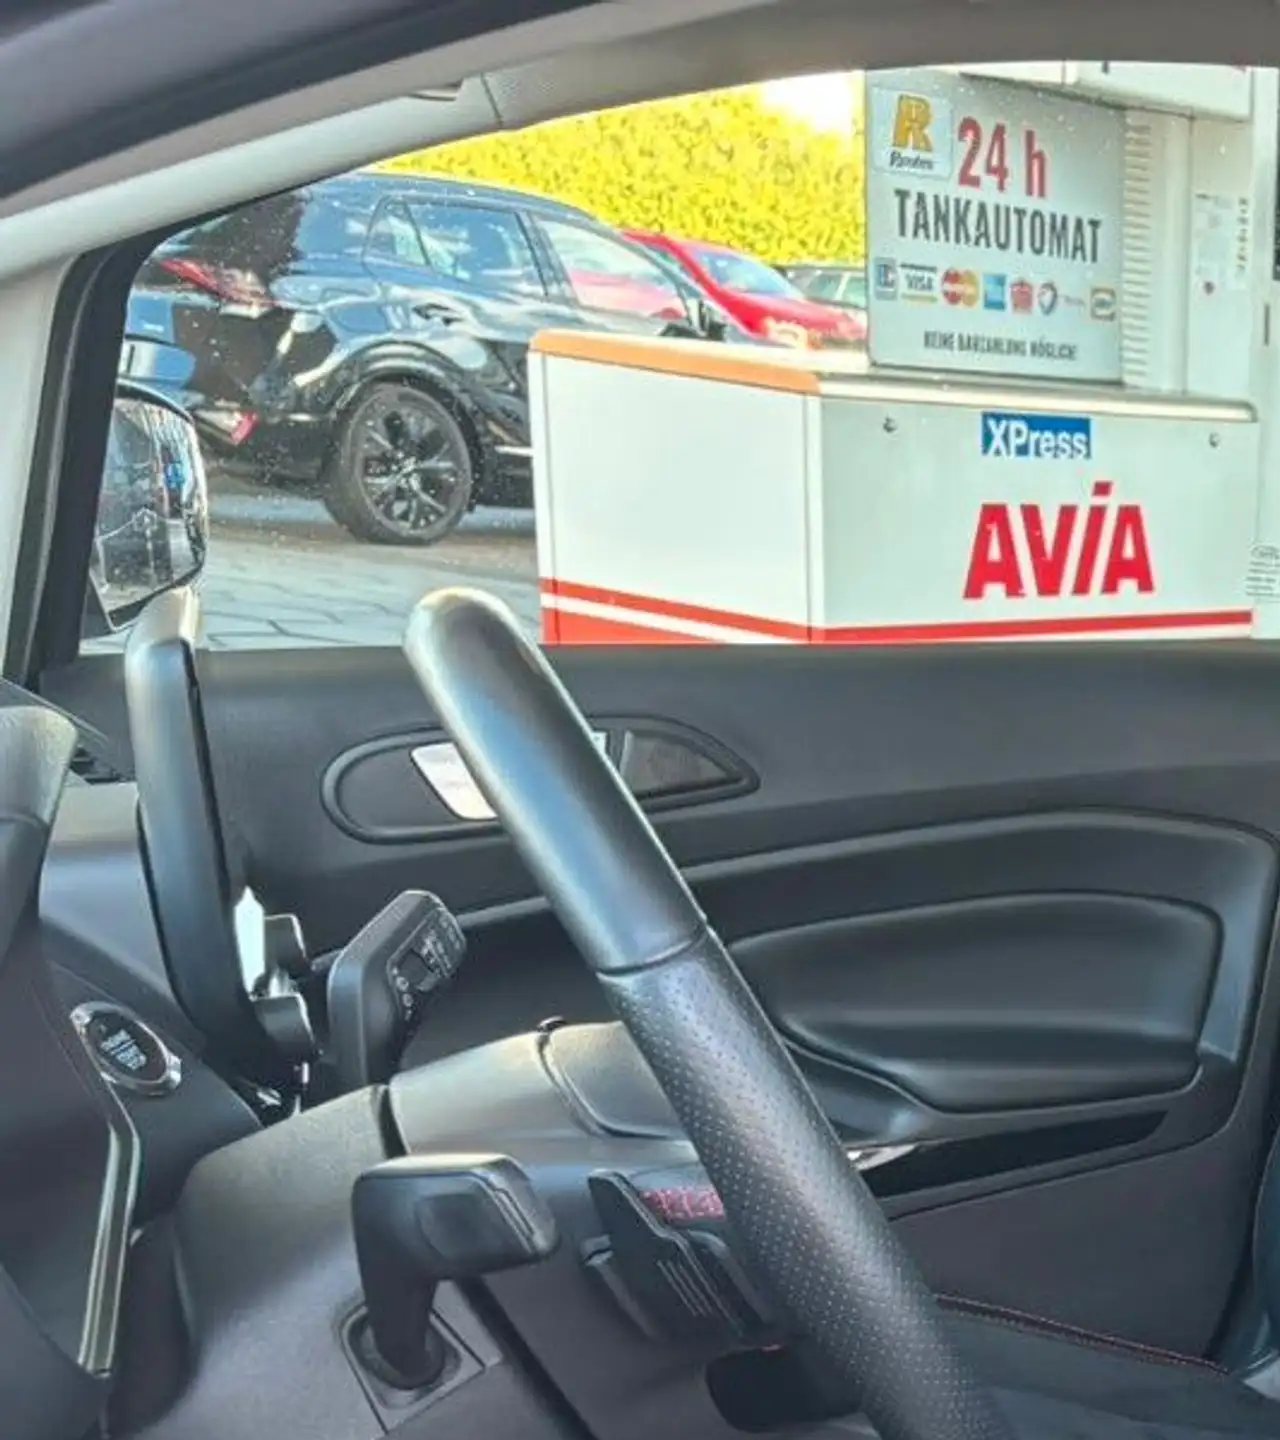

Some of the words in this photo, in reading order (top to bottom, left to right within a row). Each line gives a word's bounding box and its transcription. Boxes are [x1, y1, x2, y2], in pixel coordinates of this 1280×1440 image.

[958, 115, 1008, 193] 24
[1024, 129, 1047, 198] h
[894, 188, 1102, 264] TANKAUTOMAT
[985, 418, 1089, 460] XPress
